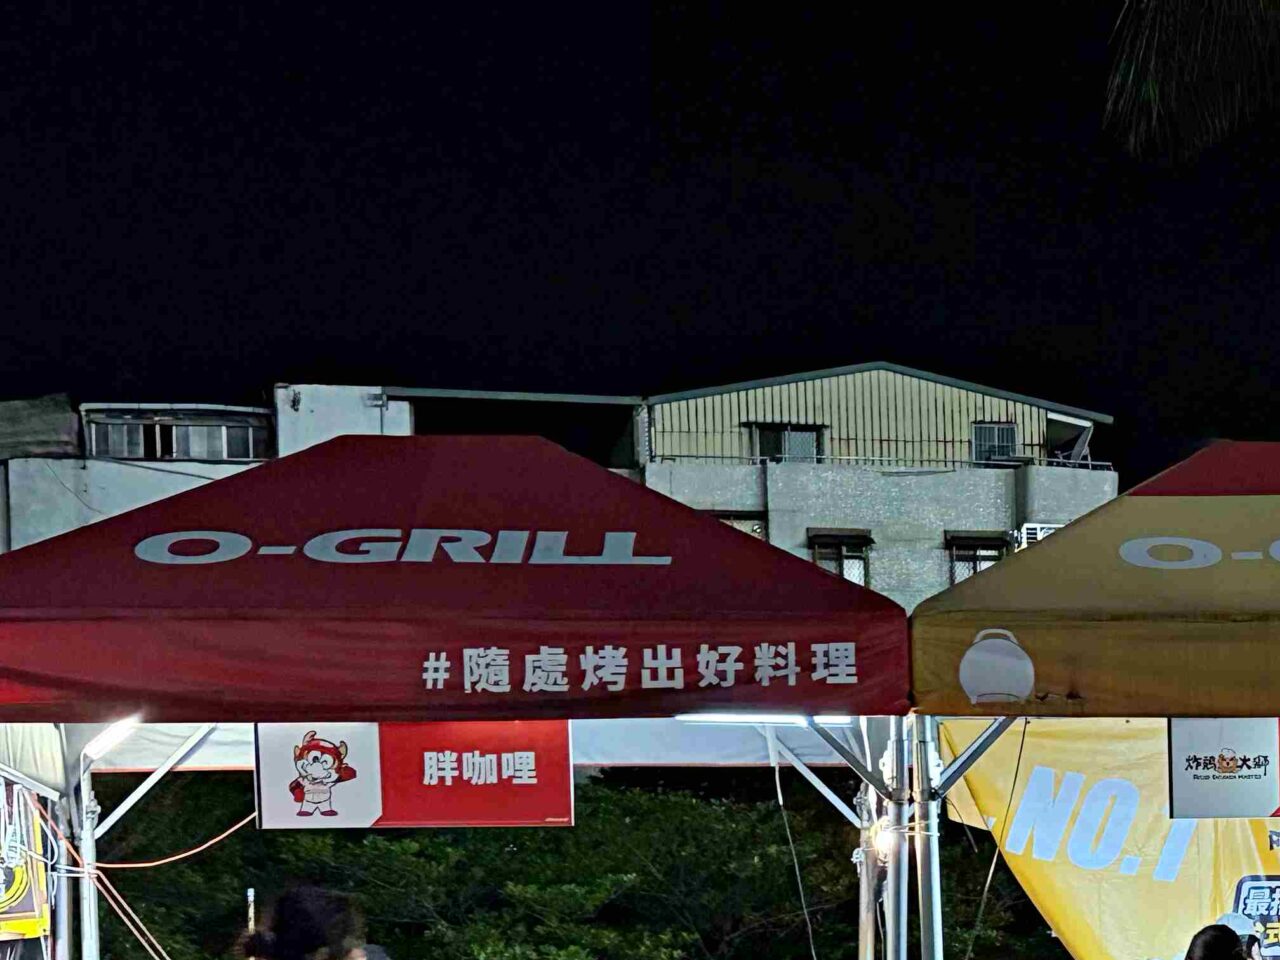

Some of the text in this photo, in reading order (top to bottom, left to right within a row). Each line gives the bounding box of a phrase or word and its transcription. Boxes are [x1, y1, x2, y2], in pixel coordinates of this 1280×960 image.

[134, 528, 673, 565] O-GRILL
[423, 750, 538, 785] 胖咖哩
